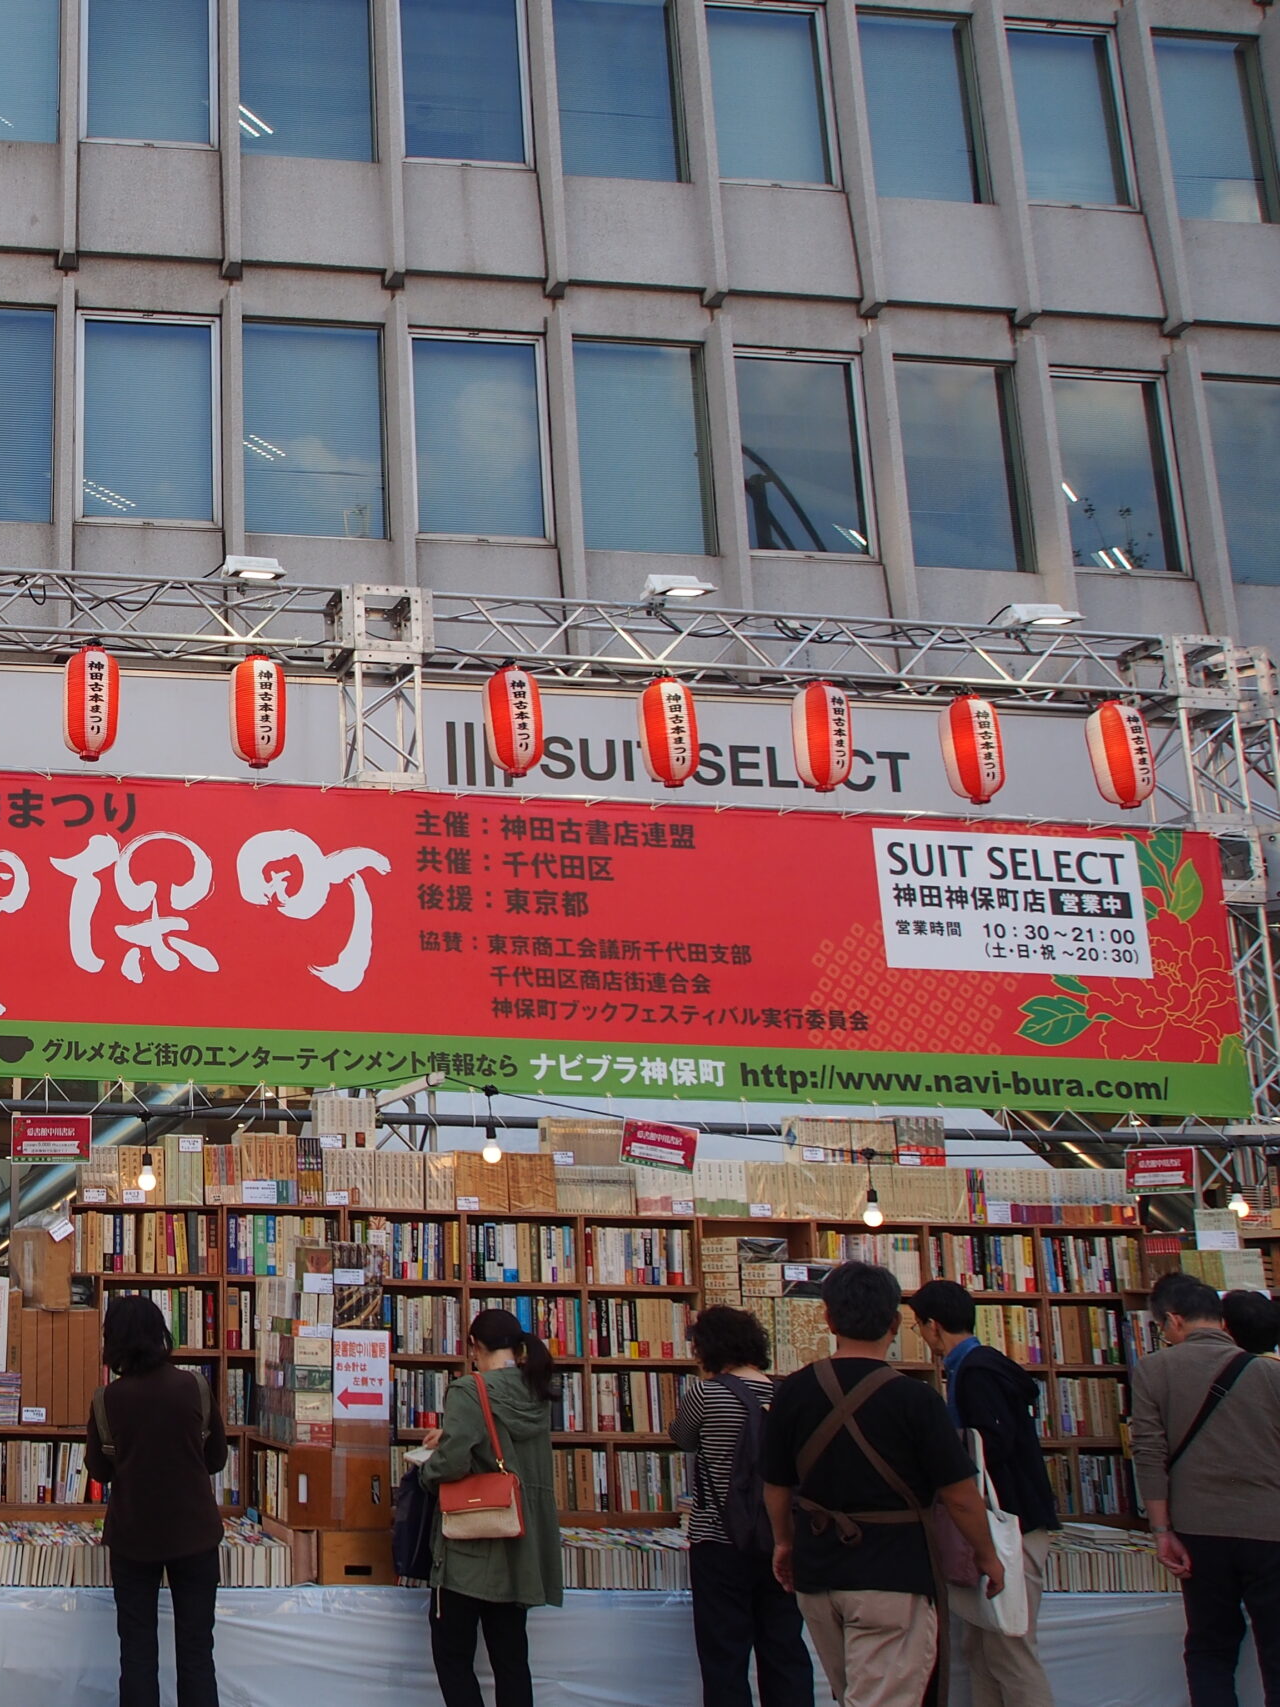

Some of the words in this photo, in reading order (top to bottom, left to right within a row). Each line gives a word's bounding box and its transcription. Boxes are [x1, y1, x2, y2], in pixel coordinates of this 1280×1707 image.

[87, 660, 106, 736] 神田古本まつり
[257, 669, 274, 746] 神田古本まつり
[510, 679, 531, 752] 神田古本まつり
[665, 691, 687, 766] 神田古本まつり
[830, 694, 848, 770] 神田古本まつり
[975, 708, 997, 782] 神田古本まつり
[1125, 713, 1152, 787] 神田古本まつり
[540, 735, 659, 783] SUI
[691, 742, 910, 793] SELCT
[886, 841, 974, 878] SUIT
[986, 846, 1126, 886] SELECT
[892, 883, 1047, 914] 神田神保町店
[1059, 893, 1122, 917] 営業中
[895, 919, 963, 938] 営業時間
[489, 964, 712, 996] 千代田区商店街連合会
[490, 997, 870, 1033] 神保町ブックフェスティバル実行委員会
[41, 1038, 519, 1079] グルメなど街のエンターテインメント情報なら
[528, 1053, 726, 1087] ナビブラ神保町
[739, 1060, 1170, 1102] http://www.navi-bura.com/
[335, 1361, 368, 1373] お会計は
[353, 1376, 384, 1387] 左側です
